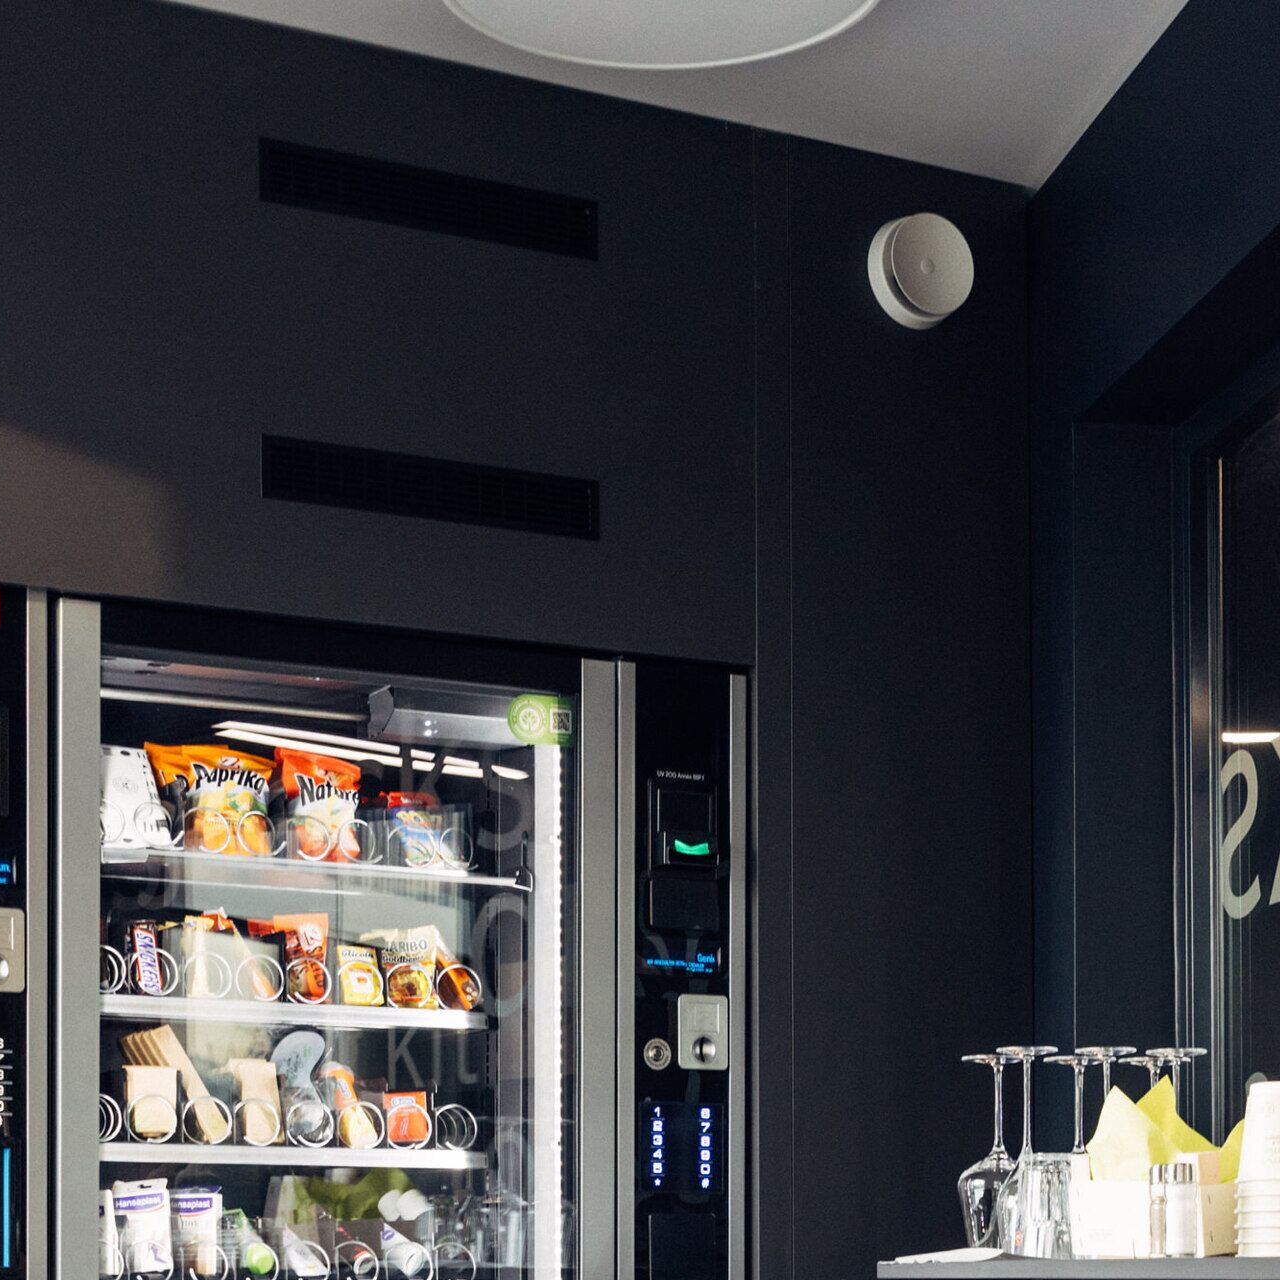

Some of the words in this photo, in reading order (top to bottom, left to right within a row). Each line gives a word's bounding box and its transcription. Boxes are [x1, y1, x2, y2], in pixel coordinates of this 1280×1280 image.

[191, 762, 266, 794] Paprika
[654, 1106, 660, 1117] 1
[652, 1120, 663, 1132] 2
[700, 1121, 711, 1133] 7
[652, 1134, 663, 1146] 3
[652, 1148, 663, 1159] 4
[700, 1163, 711, 1175] 0
[115, 1195, 161, 1209] Hansaplast
